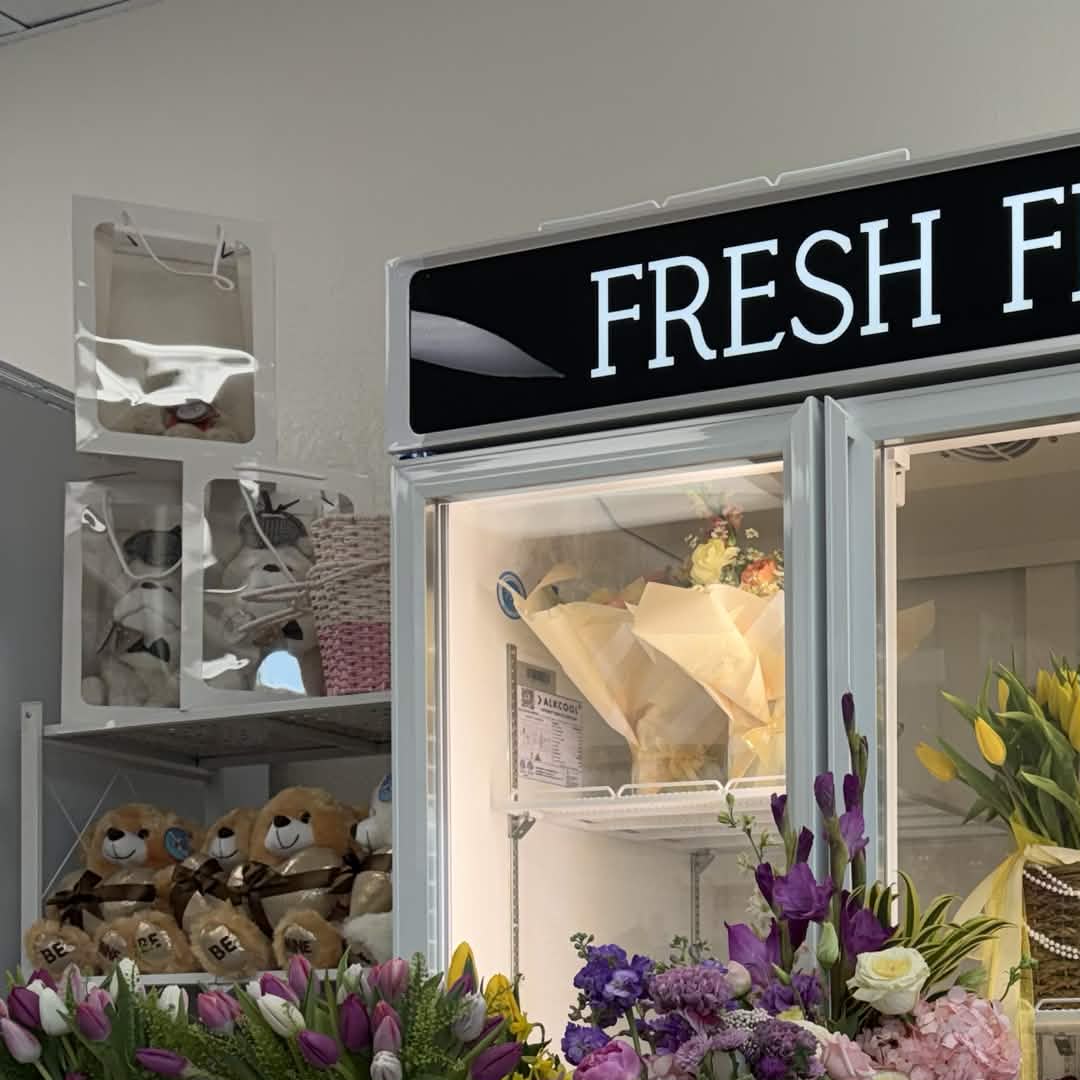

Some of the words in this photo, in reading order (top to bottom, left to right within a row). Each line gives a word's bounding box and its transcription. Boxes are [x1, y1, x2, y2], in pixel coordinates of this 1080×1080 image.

[589, 209, 942, 379] FRESH
[40, 941, 68, 964] BE
[207, 935, 237, 961] BE
